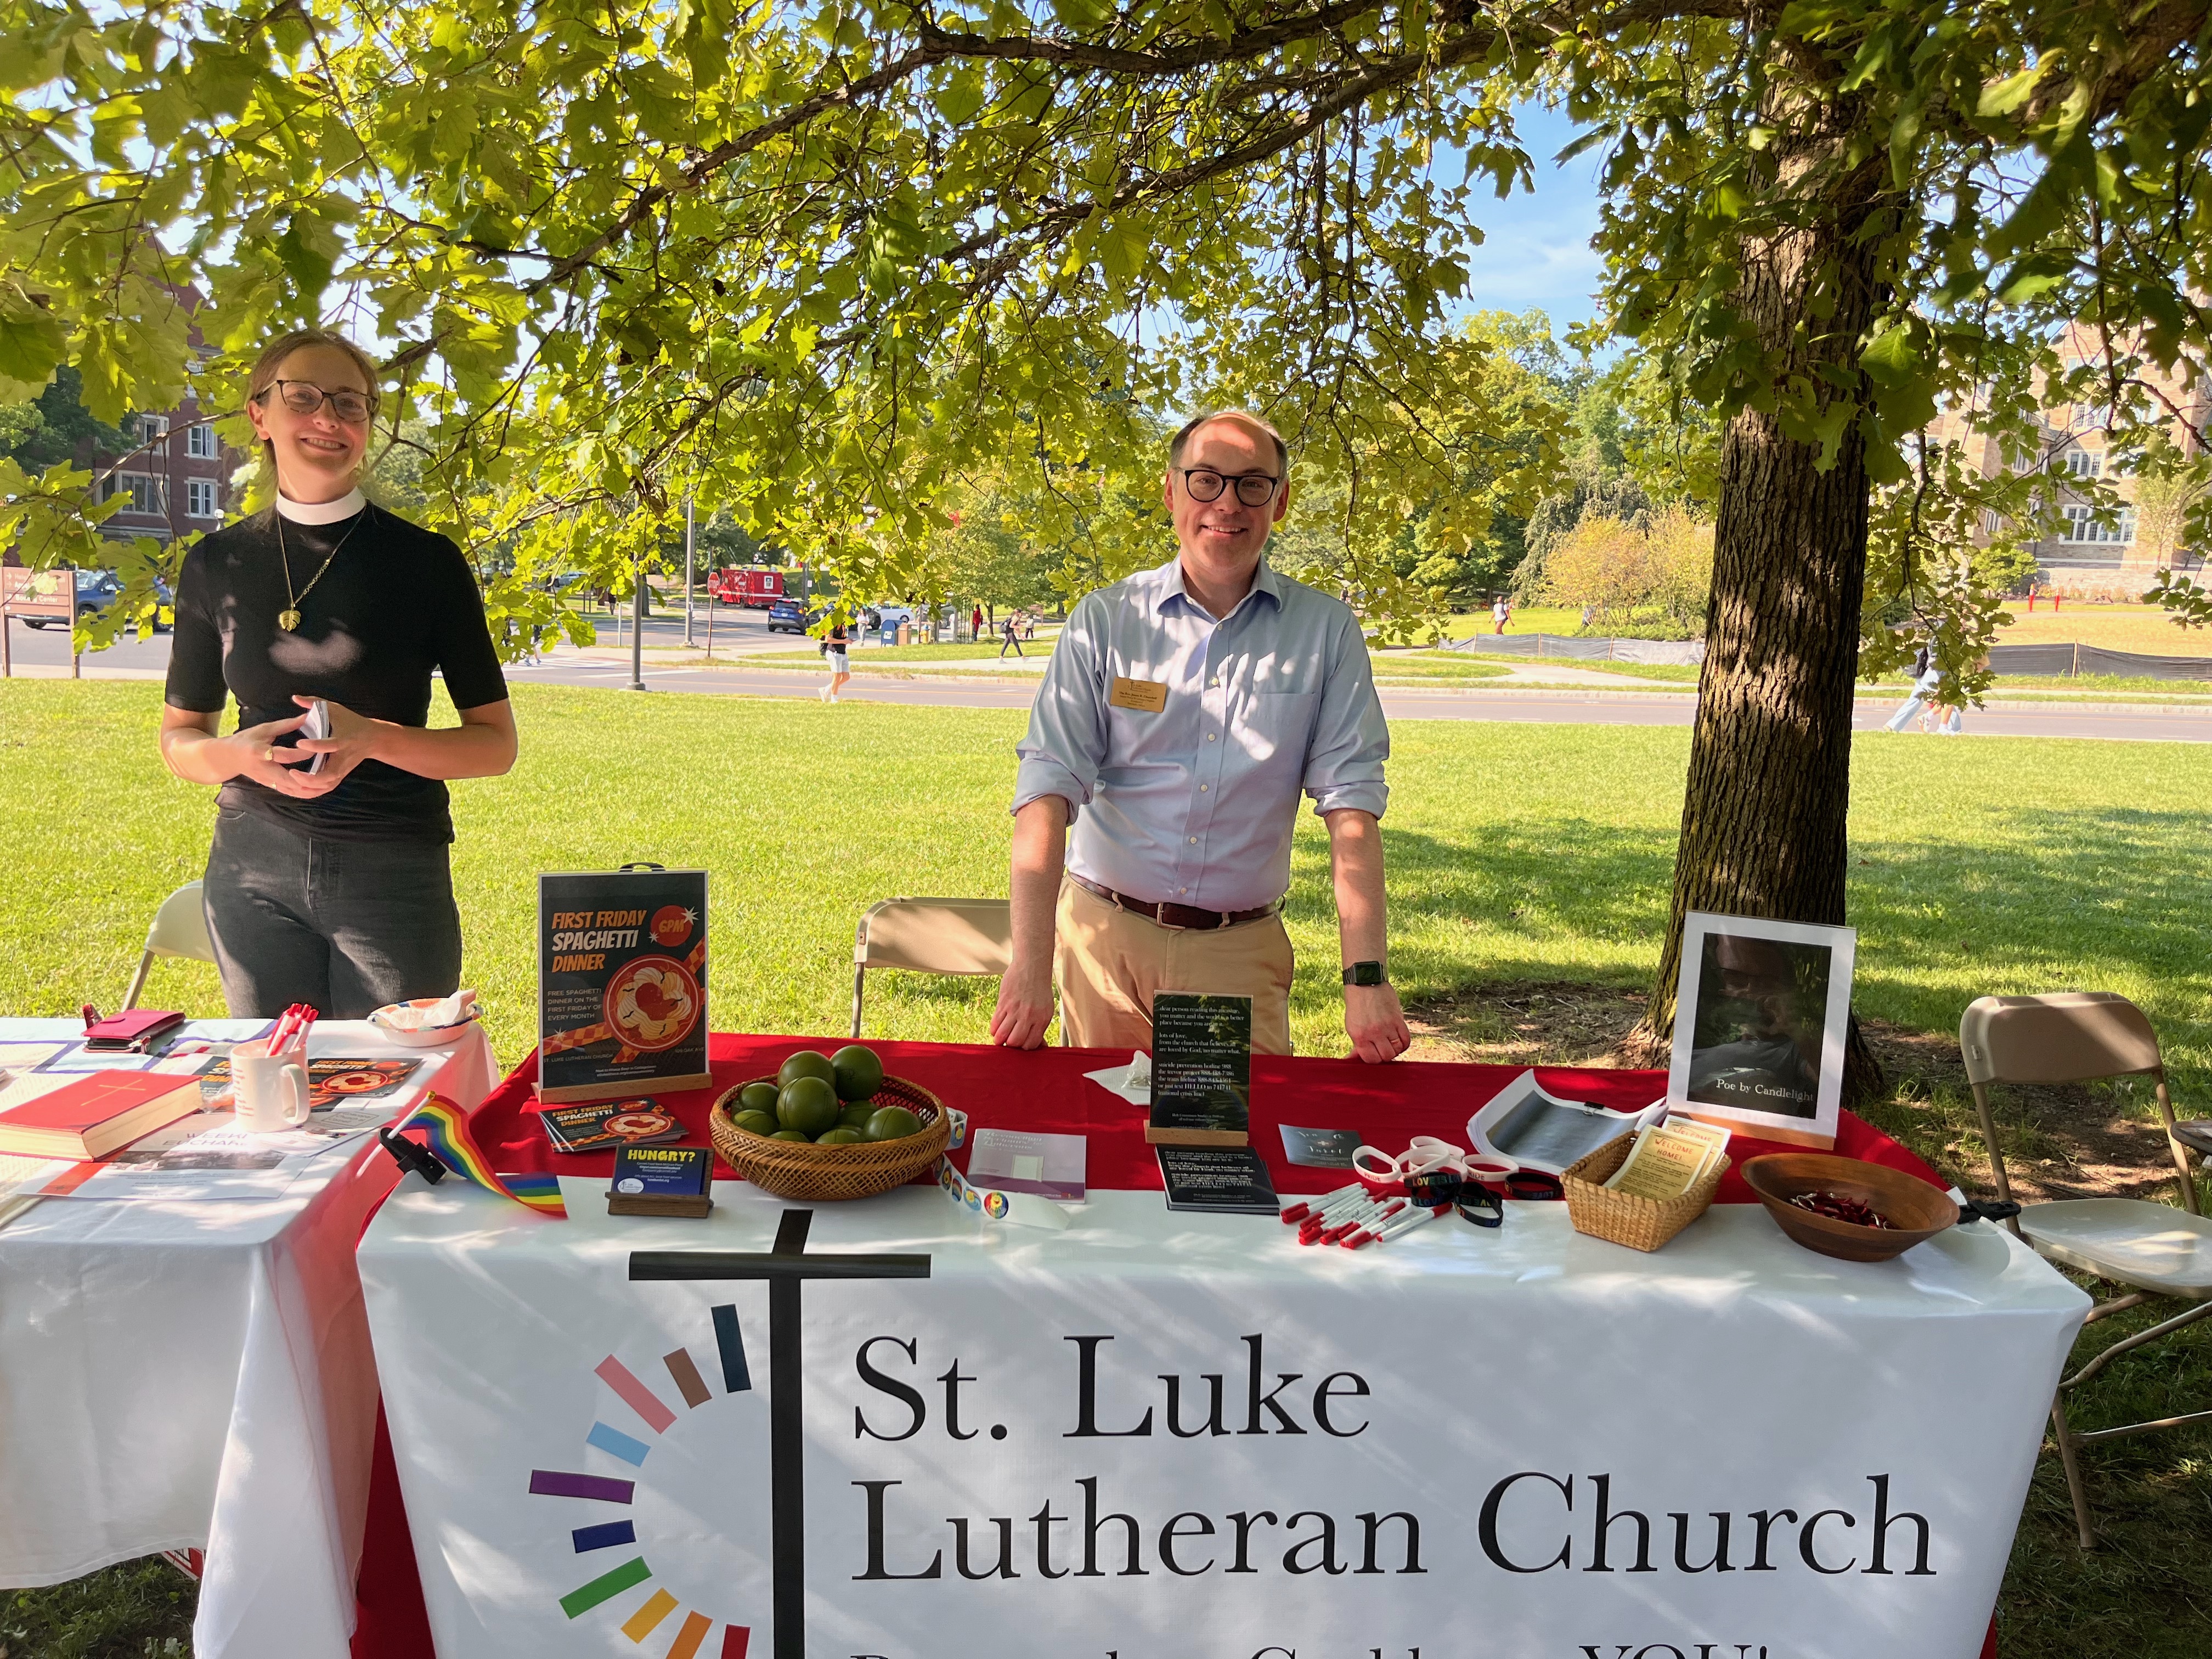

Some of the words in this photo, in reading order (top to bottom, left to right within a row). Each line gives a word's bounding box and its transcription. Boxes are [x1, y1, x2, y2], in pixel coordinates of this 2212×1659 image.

[708, 579, 719, 588] STOP
[552, 911, 594, 929] FIRST
[595, 910, 647, 928] FRIDAY
[659, 919, 685, 933] 6PM
[552, 929, 639, 951] SPAGHETTI
[551, 953, 606, 973] DINNER
[1716, 1079, 1736, 1090] Poe
[1740, 1082, 1751, 1093] by
[1755, 1084, 1814, 1103] Candlelight
[552, 1109, 578, 1118] FIRST
[580, 1104, 614, 1113] FRIDAY
[556, 1109, 613, 1122] SPAGHETTI
[561, 1116, 597, 1127] DINNER
[1655, 1138, 1694, 1154] WELCOME
[628, 1149, 696, 1162] HUNGRY?
[1657, 1149, 1683, 1160] HOME!
[1364, 1172, 1381, 1182] PRIDE
[1468, 1169, 1485, 1180] RIDE
[1413, 1177, 1436, 1187] LOVE
[856, 1337, 1007, 1441] St.
[1063, 1334, 1370, 1437] Luke
[851, 1476, 1427, 1579] Lutheran
[1479, 1472, 1936, 1575] Church
